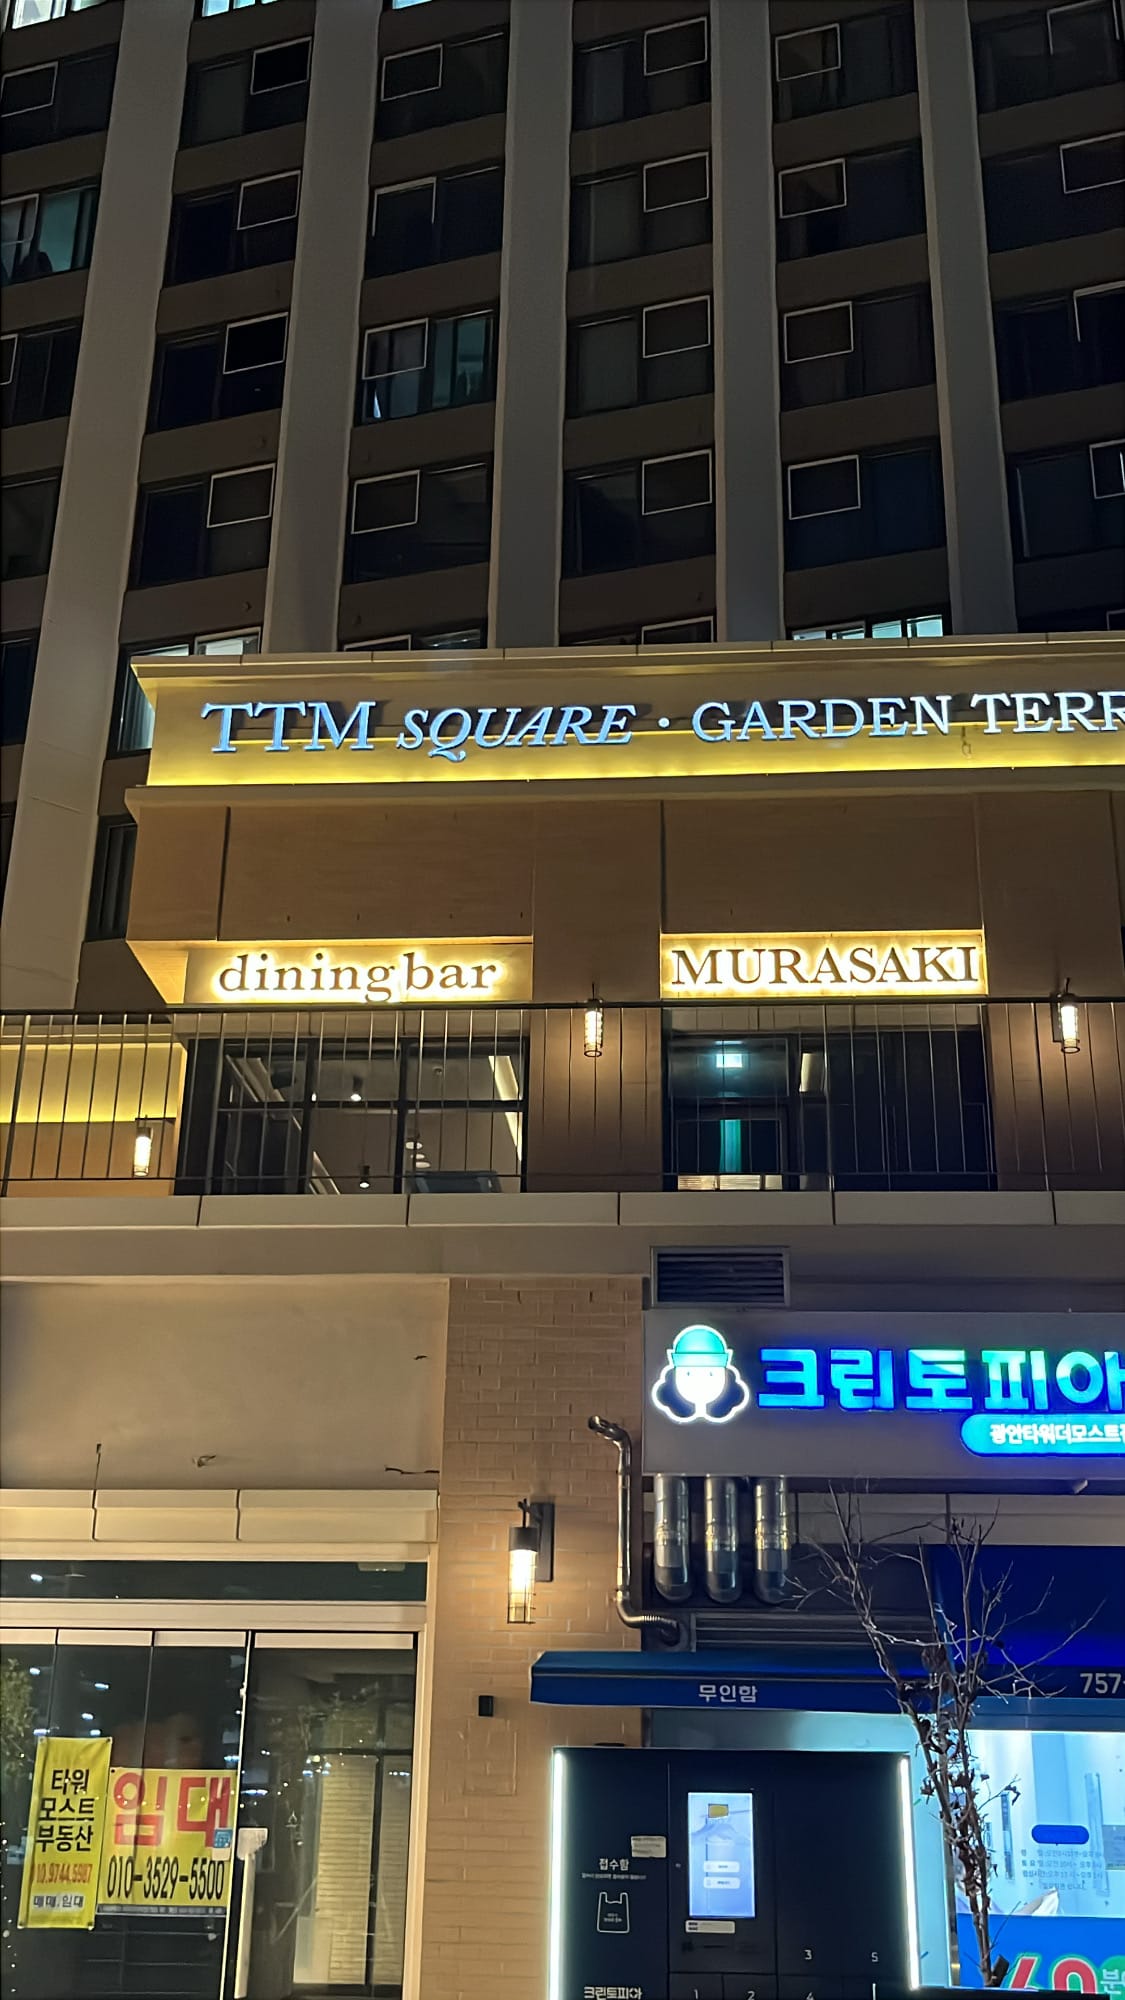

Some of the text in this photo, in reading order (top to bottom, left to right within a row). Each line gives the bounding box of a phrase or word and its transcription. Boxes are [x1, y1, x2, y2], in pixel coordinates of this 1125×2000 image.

[202, 690, 1125, 762] TTM SQUARE GARDEN TERR
[671, 946, 979, 985] MURASAKI
[759, 1348, 1125, 1411] 크린토피아
[699, 1684, 758, 1702] 무인함
[1080, 1672, 1125, 1694] 757
[51, 1768, 90, 1794] 타워
[39, 1798, 95, 1822] 모스트
[113, 1772, 232, 1848] 임대
[36, 1825, 93, 1852] 부동산
[107, 1855, 225, 1900] 010-3529-5500
[599, 1858, 630, 1871] 접수함
[805, 1949, 813, 1960] 3
